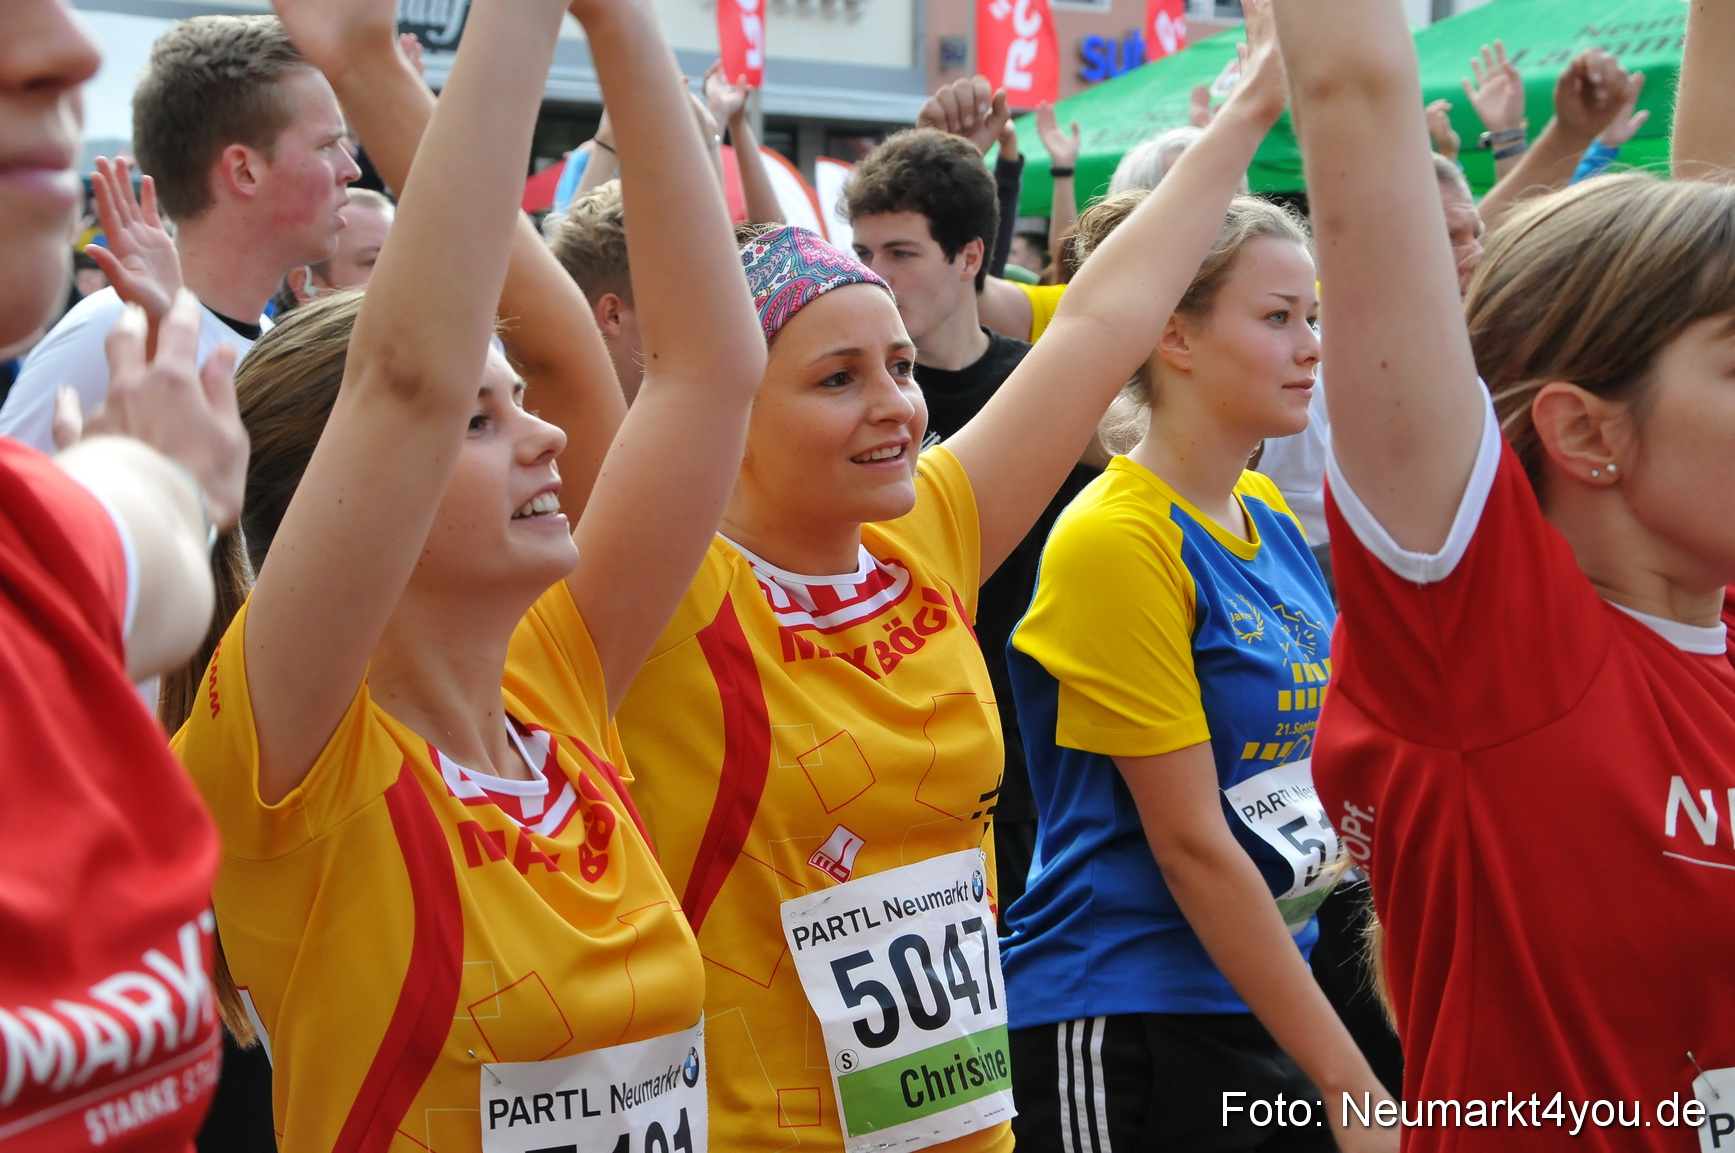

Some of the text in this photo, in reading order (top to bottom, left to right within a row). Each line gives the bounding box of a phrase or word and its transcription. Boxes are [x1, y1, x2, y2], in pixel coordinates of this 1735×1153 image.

[1665, 775, 1735, 849] N
[791, 880, 969, 951] PARTL Neumarkt
[0, 908, 215, 1104] MARK
[829, 915, 998, 1049] 5047
[488, 1087, 601, 1130] PARTL
[610, 1064, 682, 1115] Neumarkt
[1709, 1113, 1735, 1148] P
